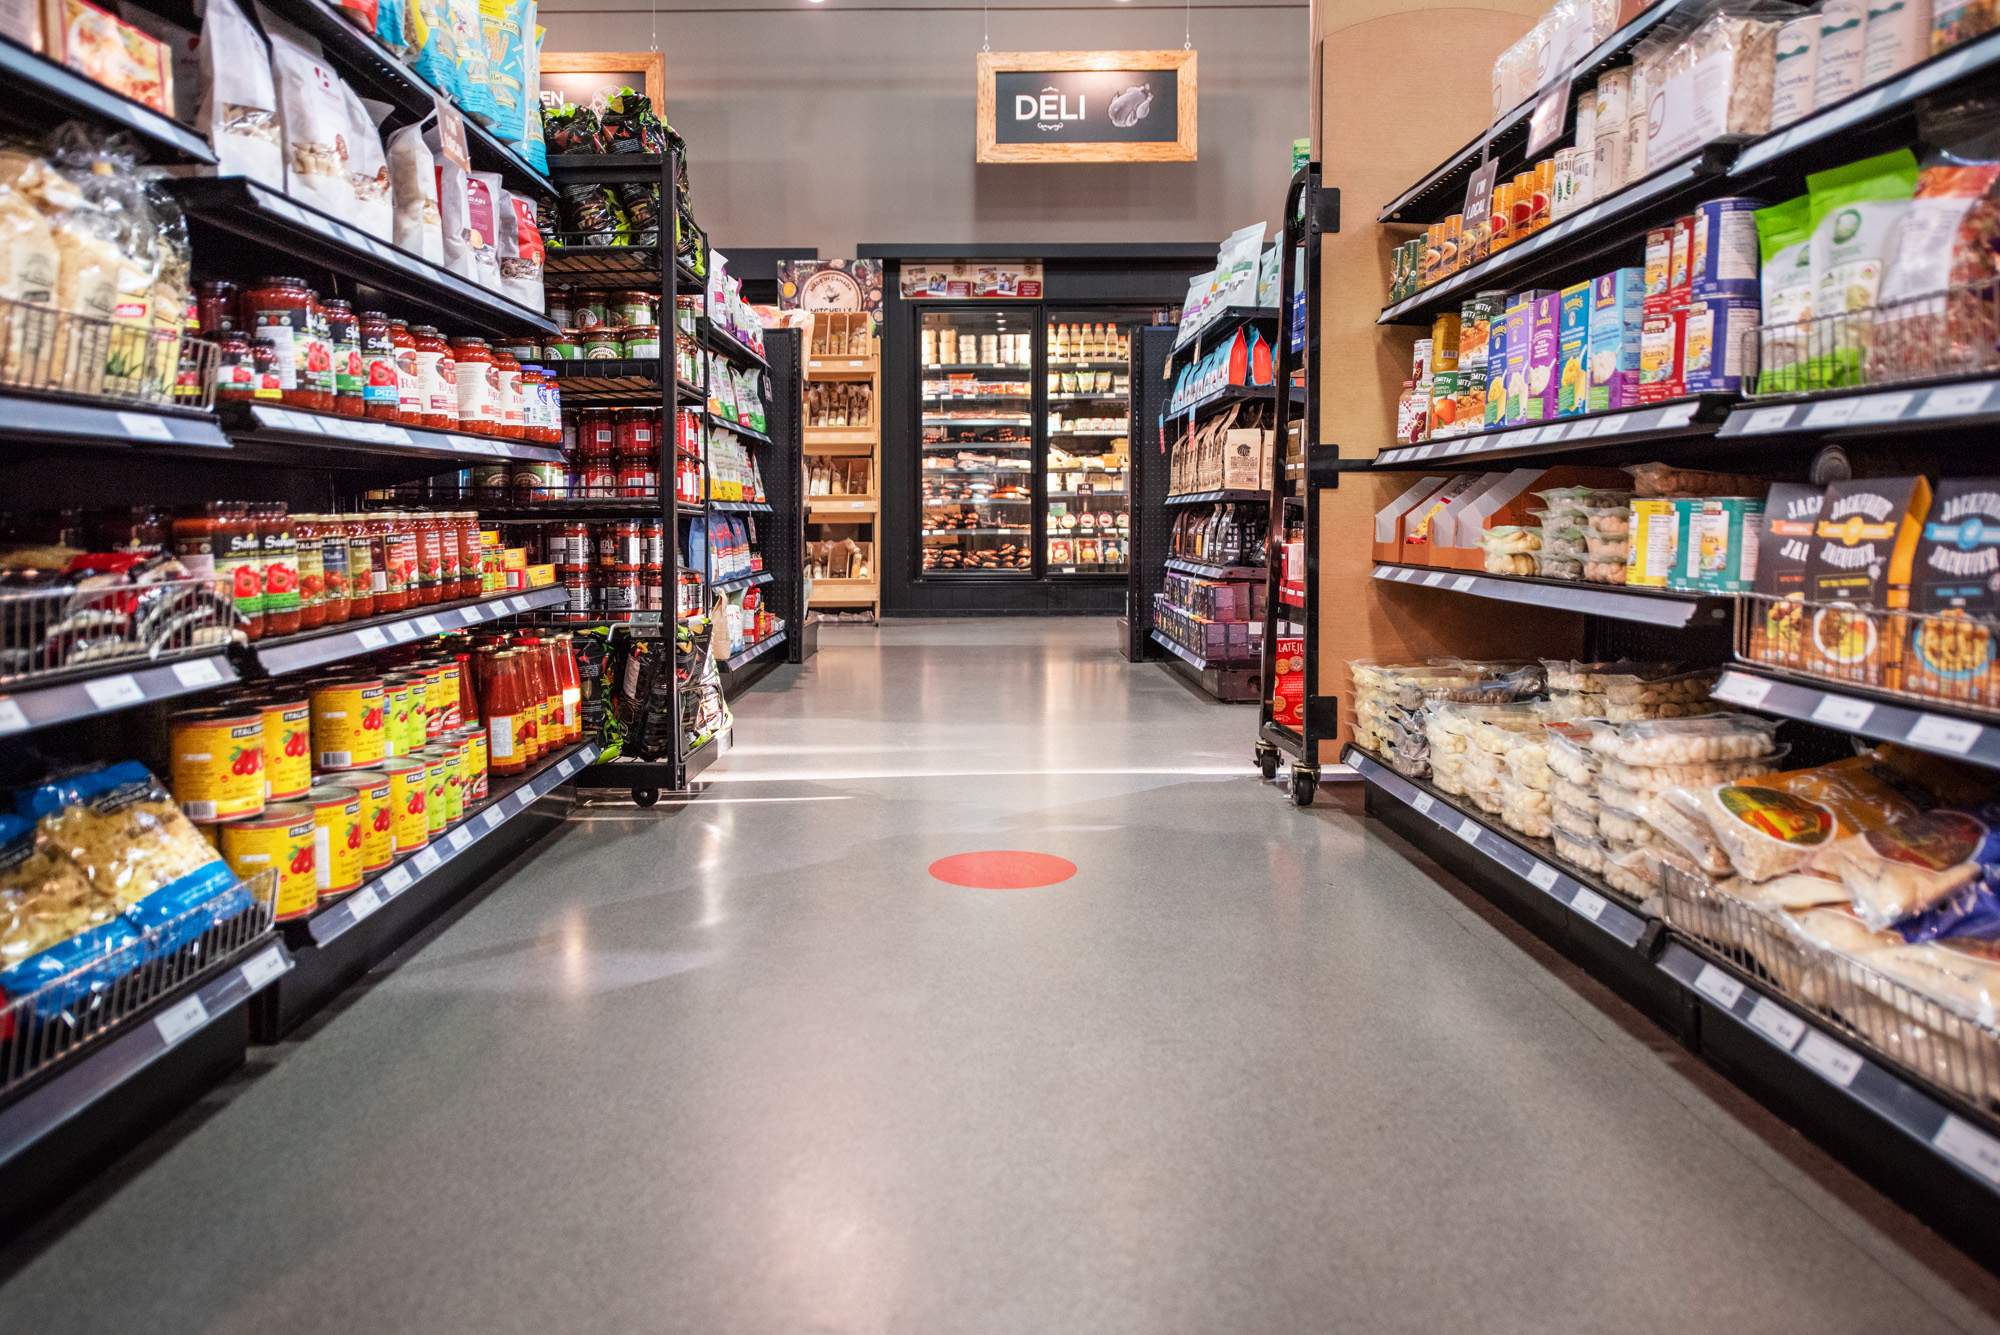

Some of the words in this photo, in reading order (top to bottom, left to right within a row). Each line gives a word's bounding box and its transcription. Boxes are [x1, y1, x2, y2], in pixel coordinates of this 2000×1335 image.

[1822, 49, 1861, 65] howder
[1778, 75, 1810, 88] howder
[1016, 94, 1085, 120] DELI
[1475, 178, 1486, 196] I'M
[1466, 198, 1486, 220] LOCAL
[810, 278, 823, 292] MADE
[831, 276, 852, 292] CANADA
